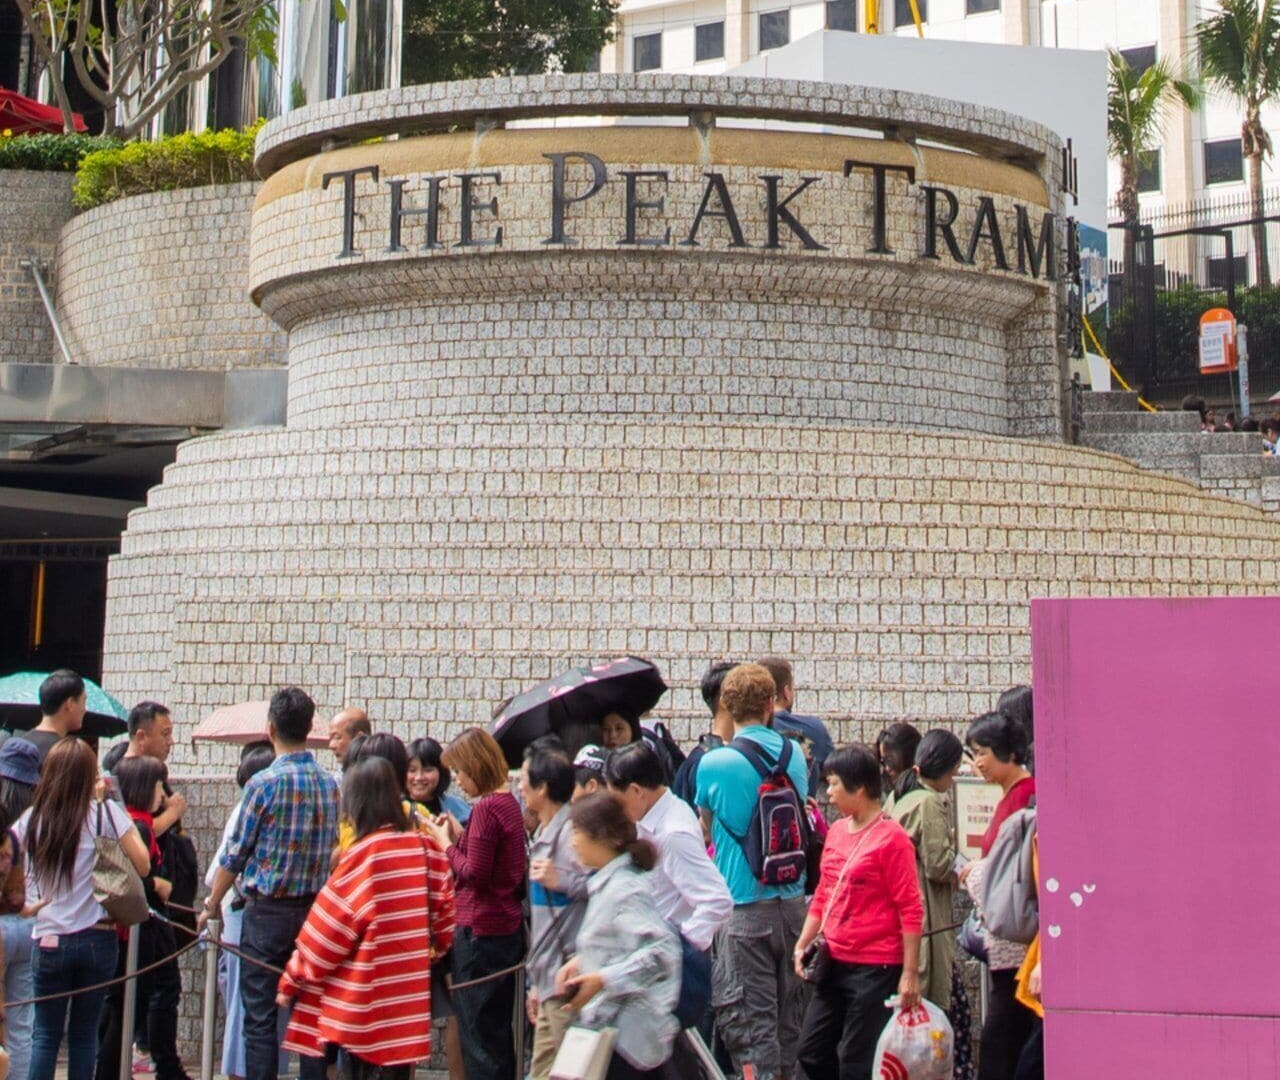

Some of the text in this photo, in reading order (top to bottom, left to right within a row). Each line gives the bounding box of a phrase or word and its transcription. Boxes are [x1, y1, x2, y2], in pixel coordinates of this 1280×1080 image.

[321, 163, 504, 260] THE
[541, 149, 831, 251] PEAK
[843, 158, 1057, 282] TRAM
